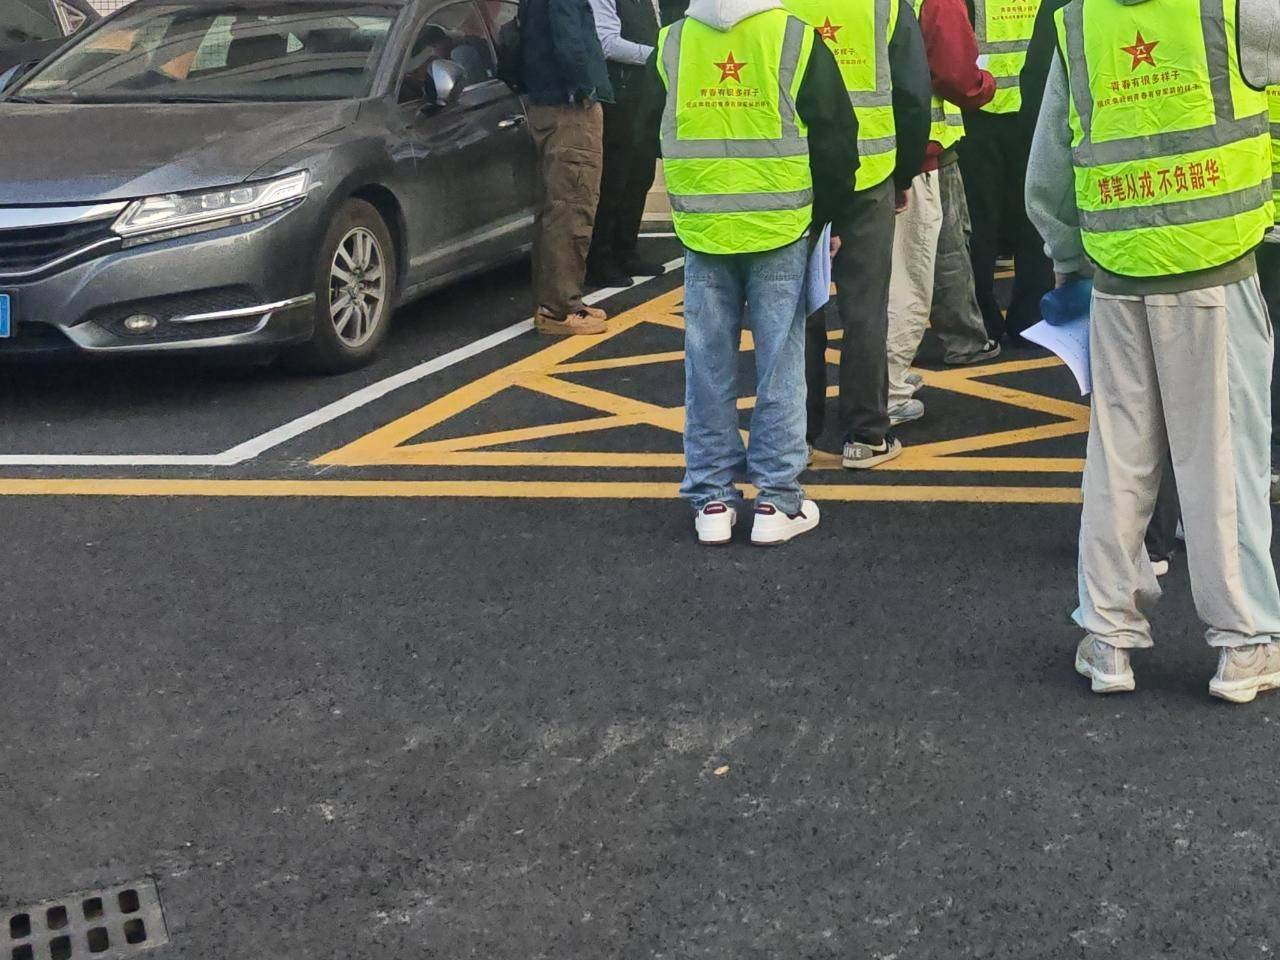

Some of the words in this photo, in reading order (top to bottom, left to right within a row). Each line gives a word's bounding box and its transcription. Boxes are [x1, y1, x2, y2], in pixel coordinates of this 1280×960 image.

[1110, 70, 1180, 92] 青春有很多样子
[700, 88, 760, 97] 青春有很多样子
[1098, 170, 1155, 205] 携笔从戎
[1157, 158, 1221, 196] 不负韶华
